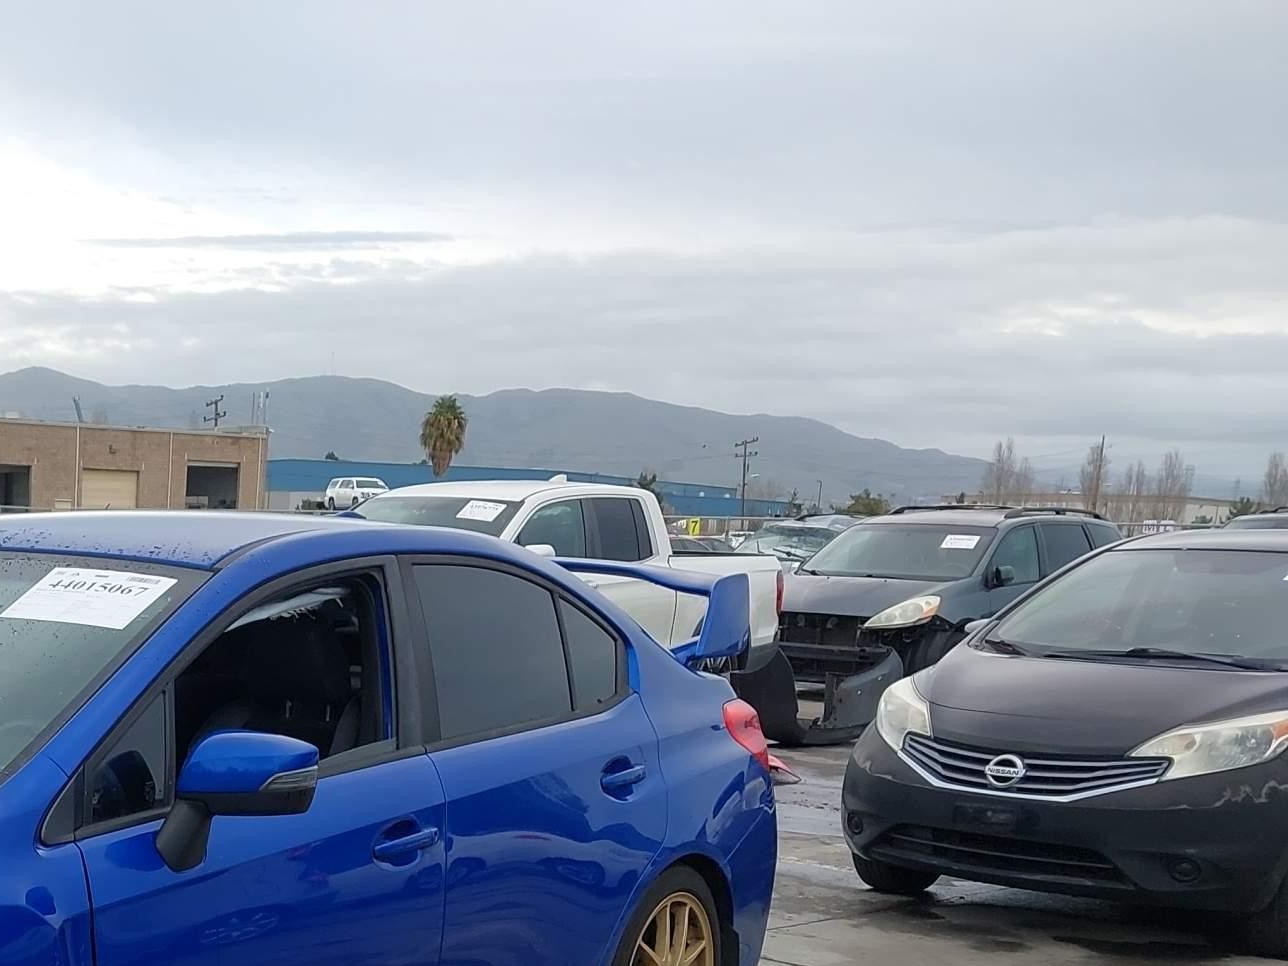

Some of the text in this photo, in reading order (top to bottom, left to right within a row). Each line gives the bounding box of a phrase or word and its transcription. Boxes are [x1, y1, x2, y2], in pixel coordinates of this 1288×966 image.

[691, 520, 699, 533] 7
[48, 579, 150, 597] 44015067
[987, 767, 1020, 776] NISSAN
